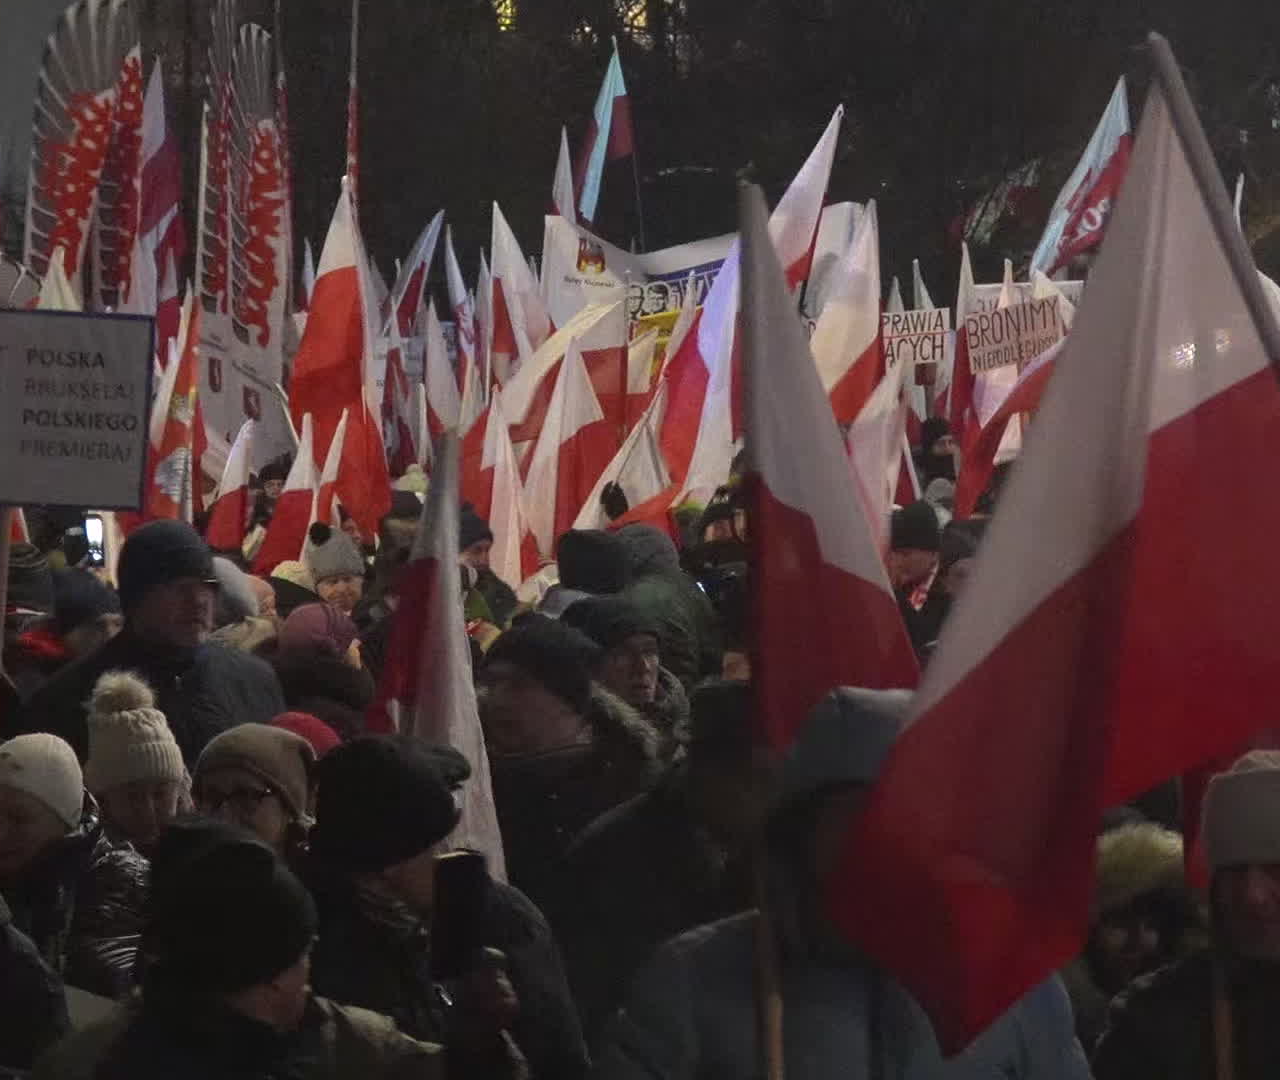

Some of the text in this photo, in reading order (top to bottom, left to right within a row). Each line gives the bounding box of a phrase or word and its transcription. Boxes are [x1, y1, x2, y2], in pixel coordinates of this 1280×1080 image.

[968, 299, 1059, 350] BRONIMY
[26, 348, 105, 370] POLSKA
[23, 409, 138, 431] POLSKIEGO
